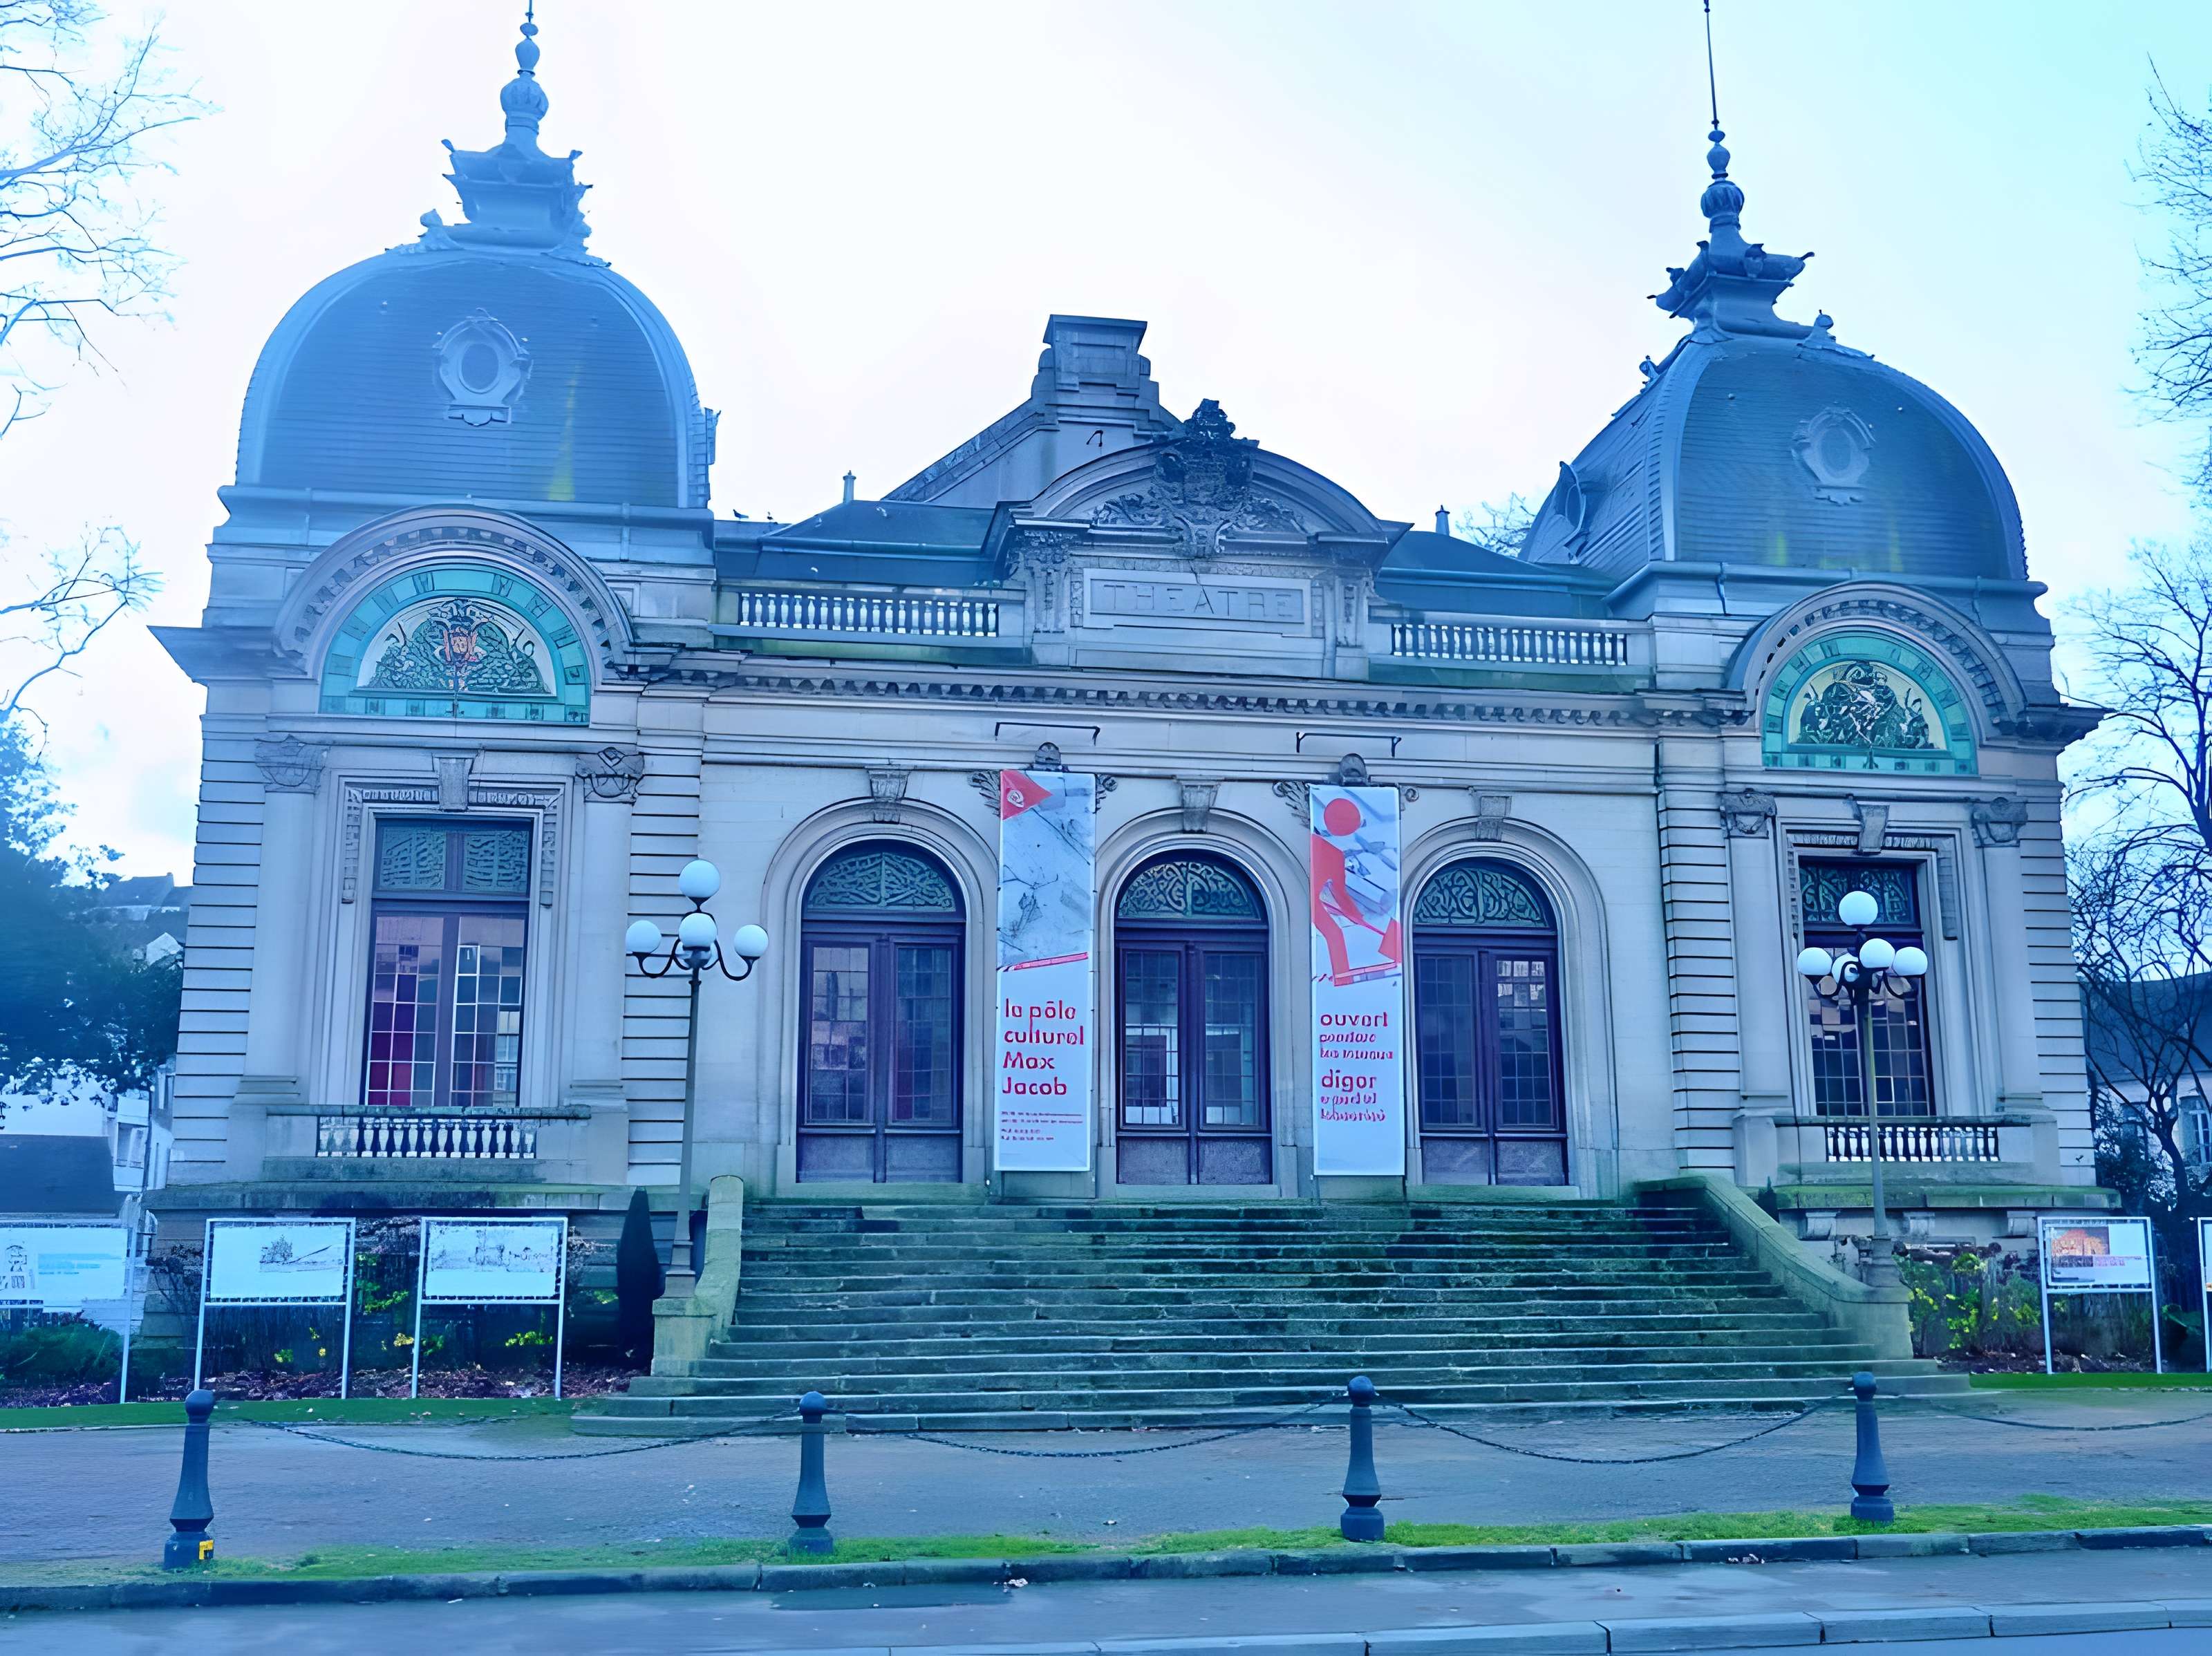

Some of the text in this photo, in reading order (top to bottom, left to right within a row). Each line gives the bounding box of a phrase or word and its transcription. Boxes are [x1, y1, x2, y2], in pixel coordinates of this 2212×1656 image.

[1103, 585, 1293, 617] THEATRE
[1003, 1051, 1055, 1069] Max
[1002, 1076, 1067, 1095] Jacob
